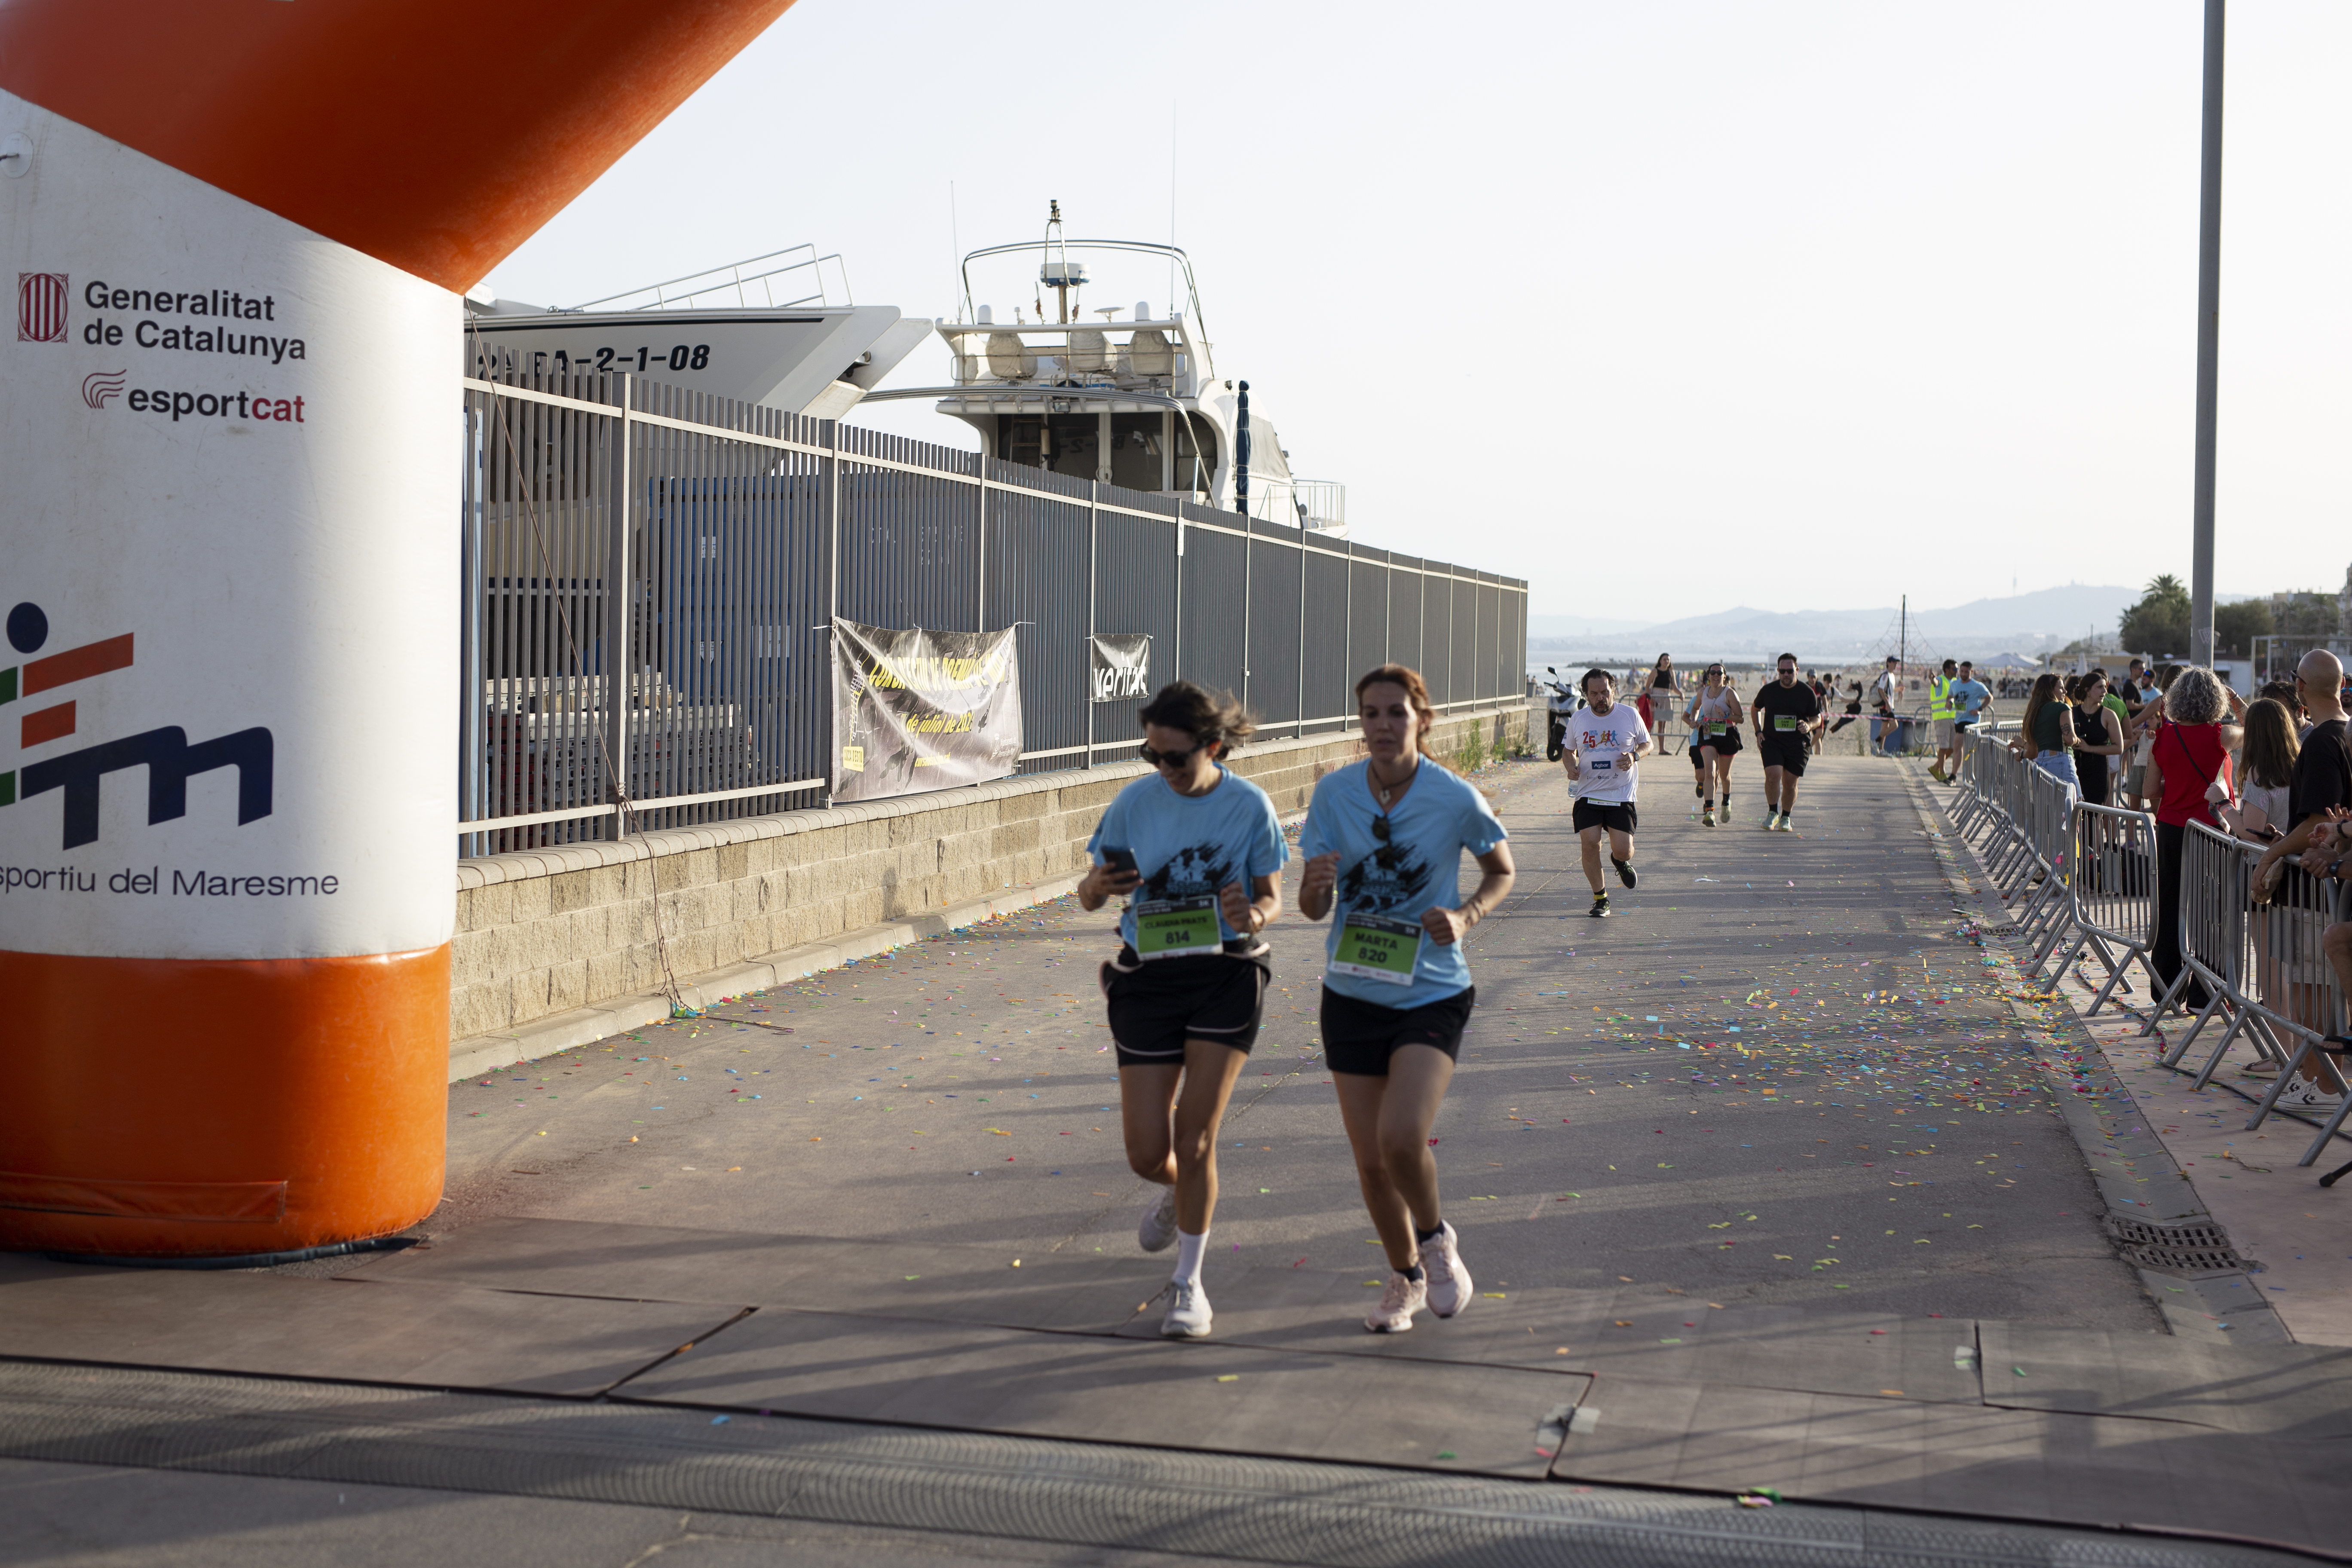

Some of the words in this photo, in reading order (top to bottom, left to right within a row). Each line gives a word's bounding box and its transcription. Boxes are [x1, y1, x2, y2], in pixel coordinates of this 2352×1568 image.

[85, 281, 275, 321] Generalitat
[84, 318, 123, 345] de
[135, 320, 306, 364] Catalunya
[129, 388, 305, 423] esportcat
[906, 714, 919, 733] de
[916, 714, 947, 739] juliol
[943, 714, 956, 733] de
[1583, 731, 1596, 748] 25
[108, 865, 158, 894] del
[172, 870, 339, 896] Maresme
[1165, 930, 1190, 944] 814
[1355, 932, 1398, 949] MARTA
[1358, 947, 1387, 963] 820
